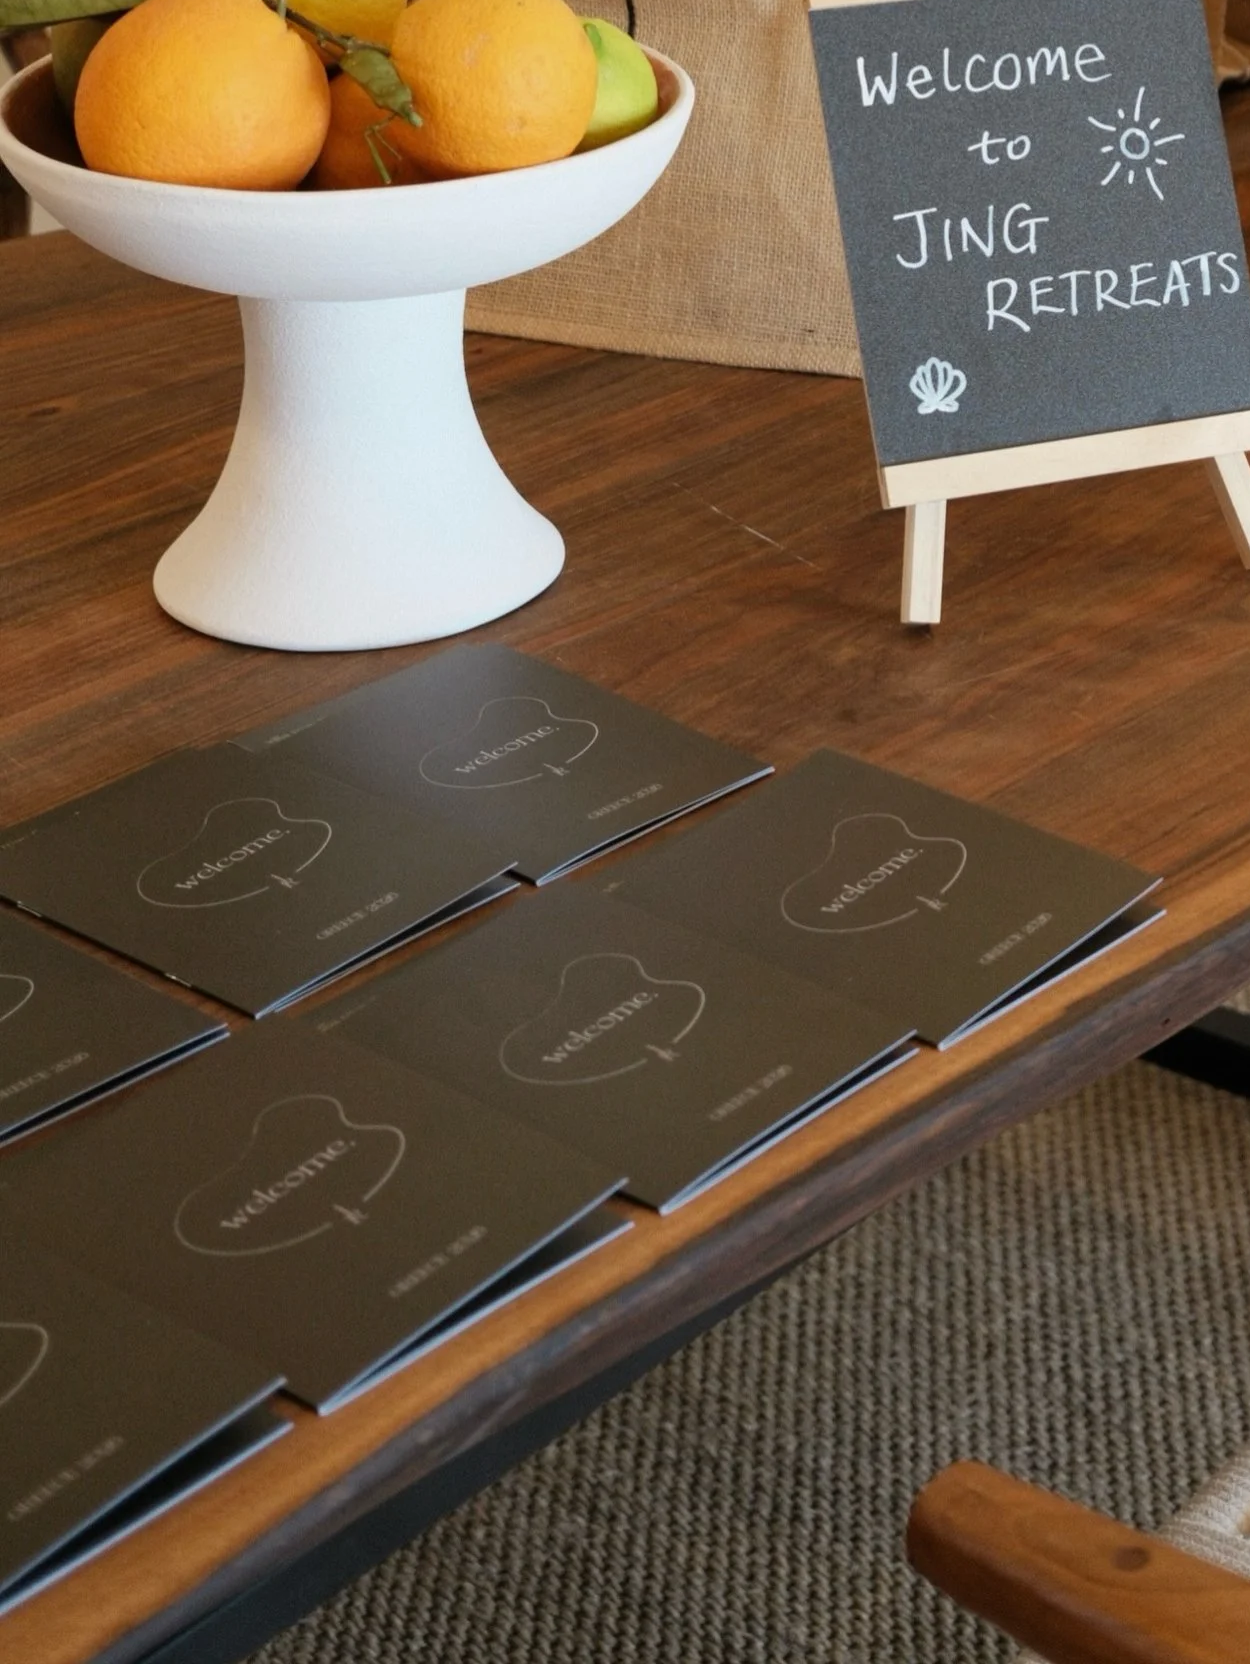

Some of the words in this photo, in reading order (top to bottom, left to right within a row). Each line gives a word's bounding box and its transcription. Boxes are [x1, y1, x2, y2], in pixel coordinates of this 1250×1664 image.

[857, 42, 1112, 107] Welcome
[967, 131, 1031, 165] to
[893, 202, 1049, 269] JING
[986, 251, 1241, 332] RETREATS
[453, 724, 561, 774] welcome.
[174, 827, 292, 891] welcome.
[820, 846, 924, 914] welcome.
[542, 991, 659, 1064] welcome.
[220, 1138, 357, 1230] welcome.
